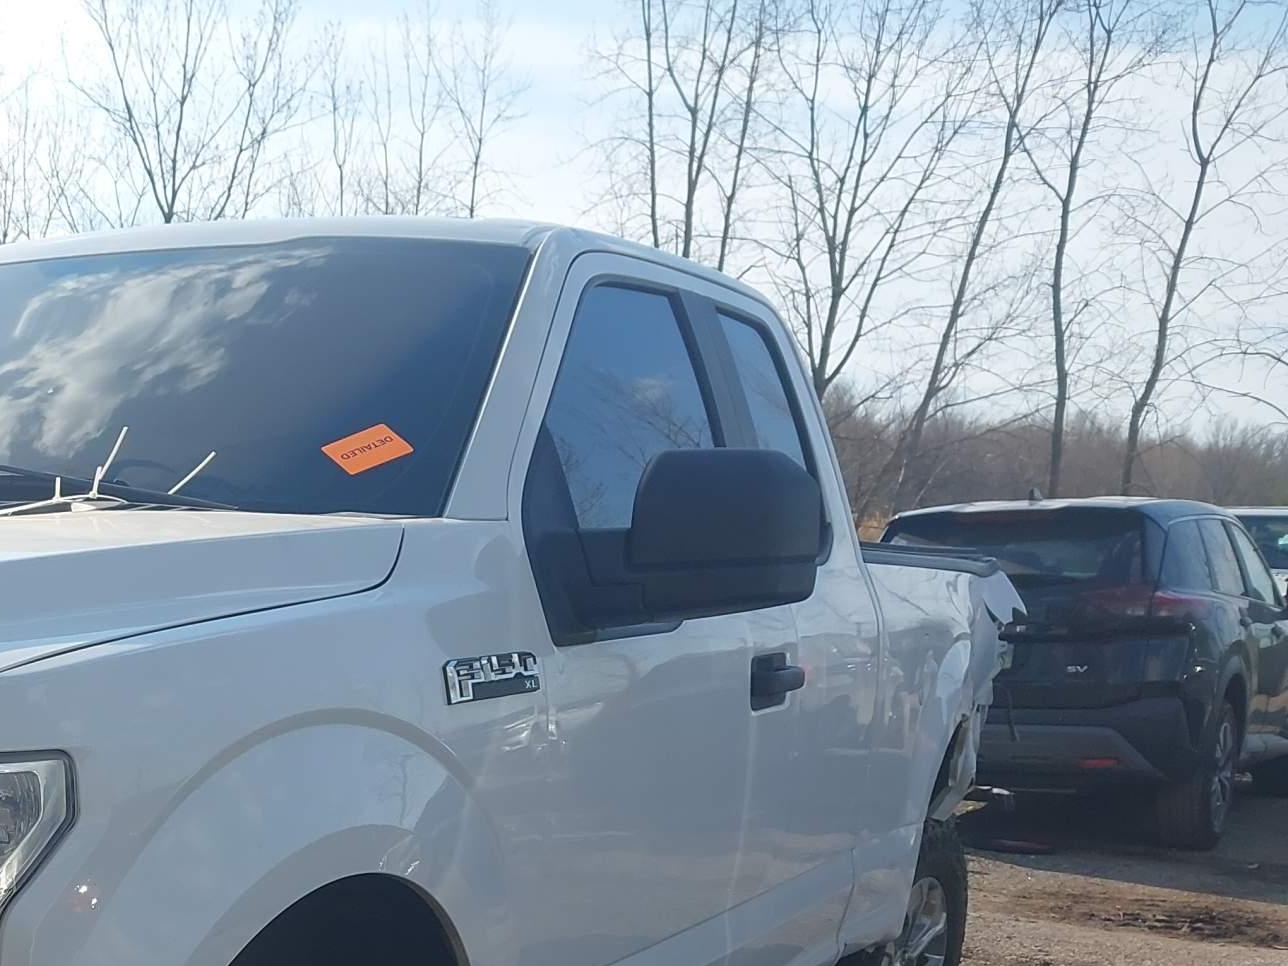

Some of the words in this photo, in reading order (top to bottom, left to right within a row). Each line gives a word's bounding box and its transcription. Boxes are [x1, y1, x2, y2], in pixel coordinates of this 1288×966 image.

[340, 435, 394, 460] DETAILED
[1066, 665, 1089, 673] SV
[524, 680, 537, 689] XL
